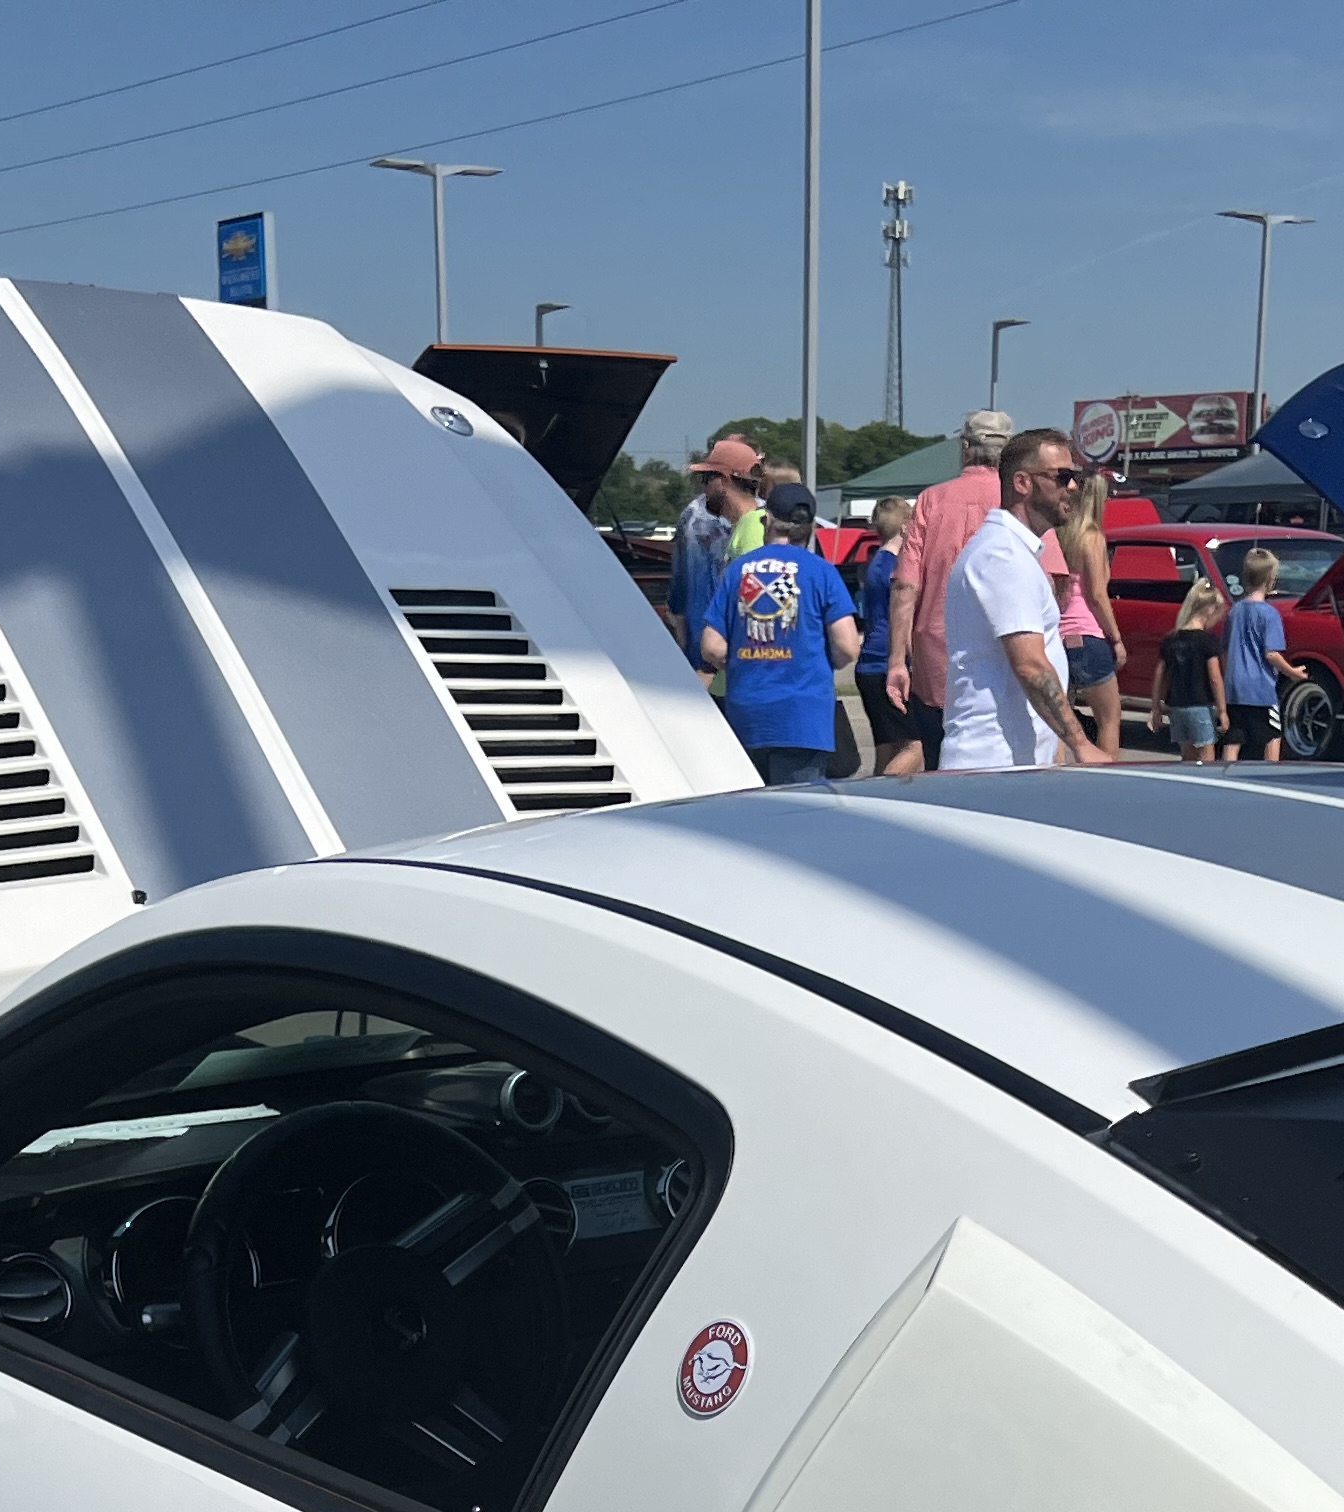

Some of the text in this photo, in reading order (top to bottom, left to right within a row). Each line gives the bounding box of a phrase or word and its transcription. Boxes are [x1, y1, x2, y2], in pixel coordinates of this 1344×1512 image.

[741, 559, 799, 574] NCRS
[708, 1324, 742, 1346] FORD
[682, 1375, 733, 1408] MUSTANG
